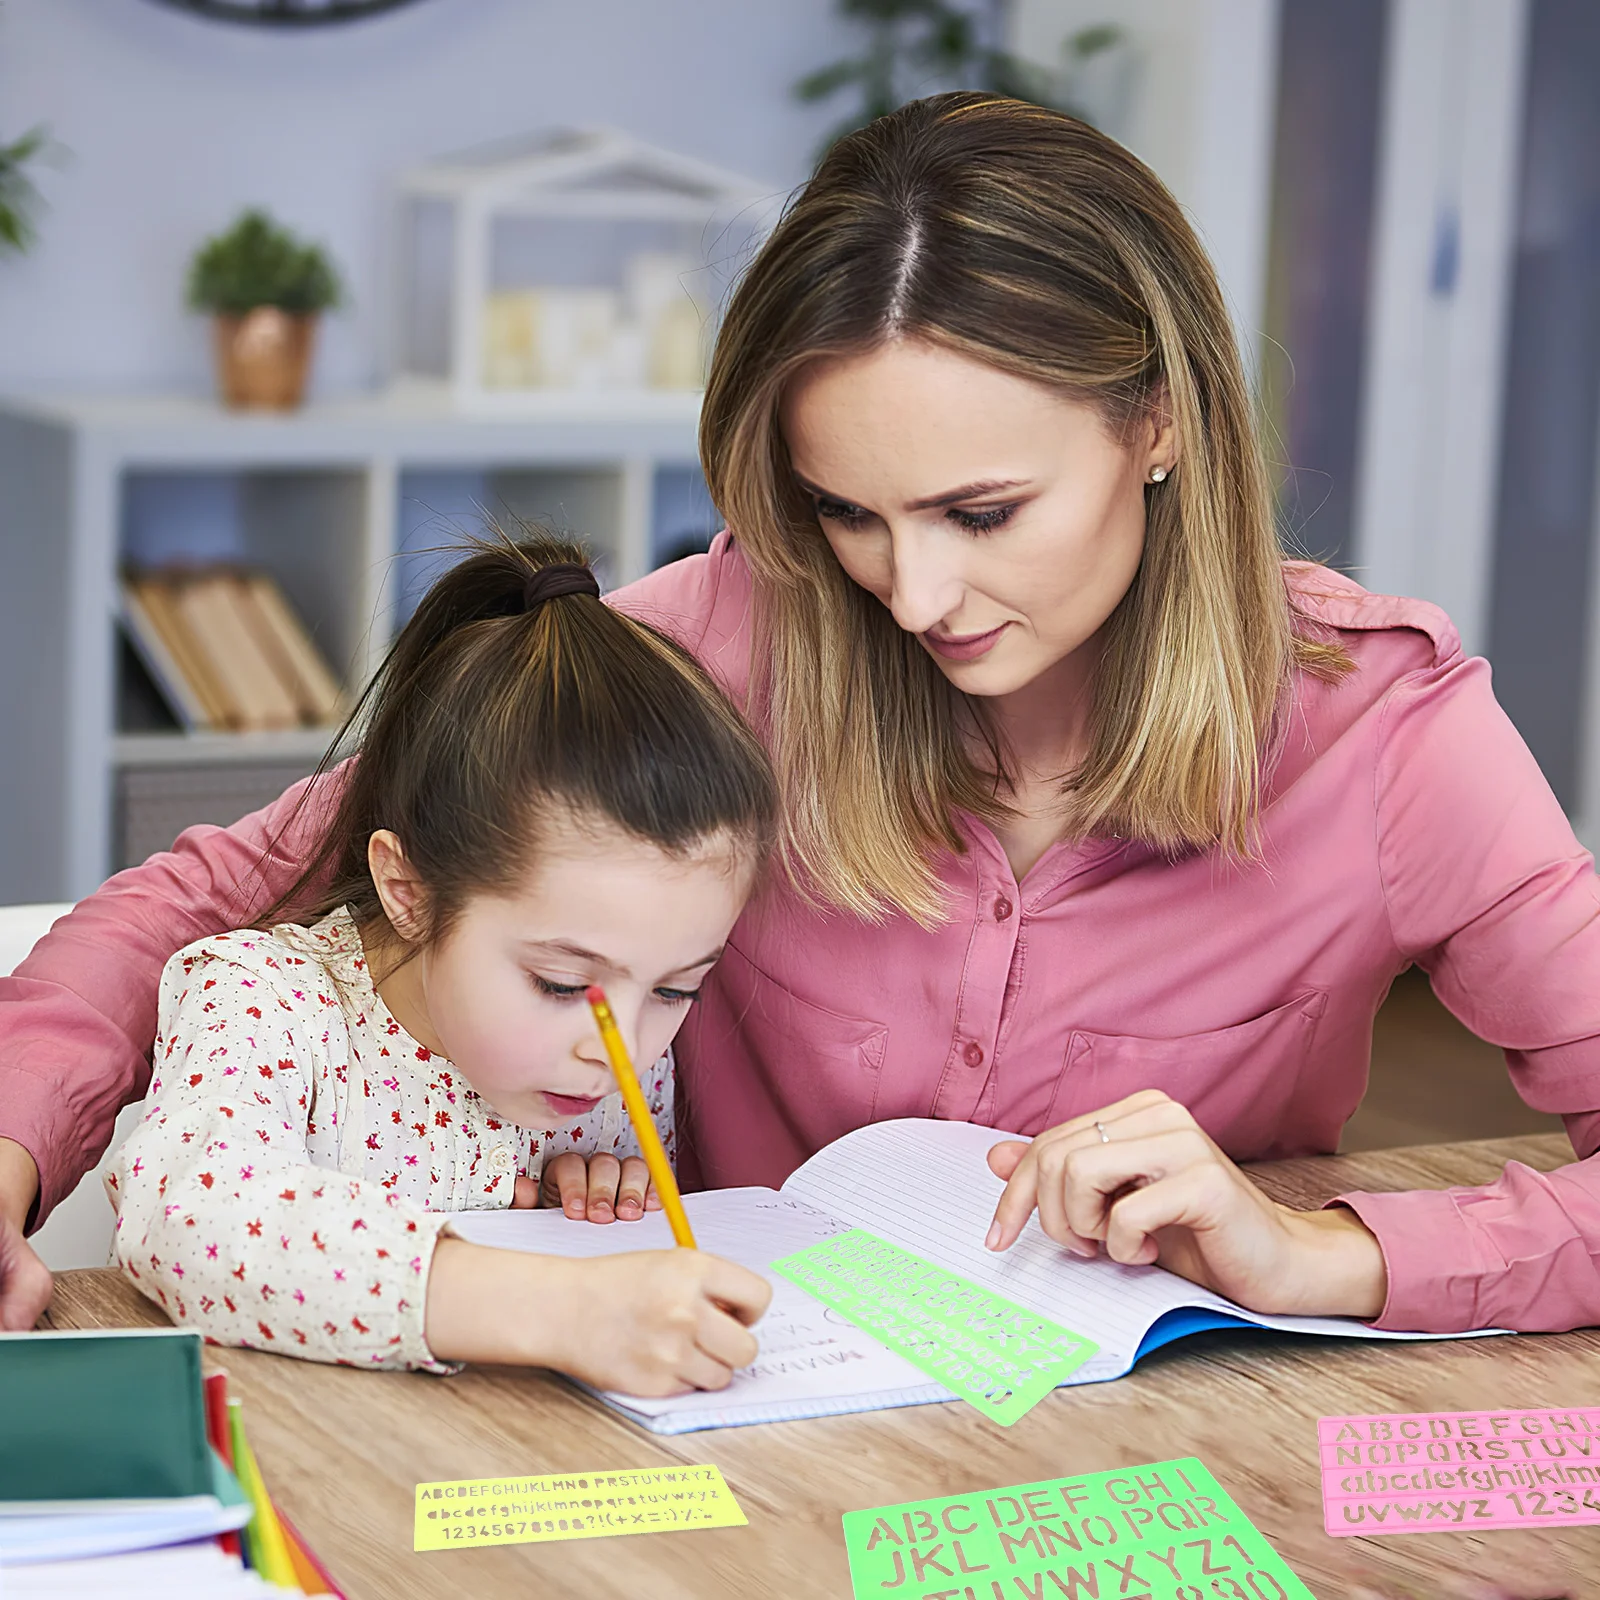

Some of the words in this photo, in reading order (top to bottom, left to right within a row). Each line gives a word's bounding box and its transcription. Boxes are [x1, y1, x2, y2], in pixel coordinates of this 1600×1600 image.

[845, 1235, 1083, 1357] ABCDEFGHIJKLM
[850, 1300, 1013, 1406] 1234567890
[1335, 1414, 1600, 1442] ABCDEFGHI
[1336, 1436, 1600, 1466] NOPQRSTUV
[1340, 1462, 1600, 1493] abcdefghijklm
[1343, 1499, 1494, 1524] uvwxyz
